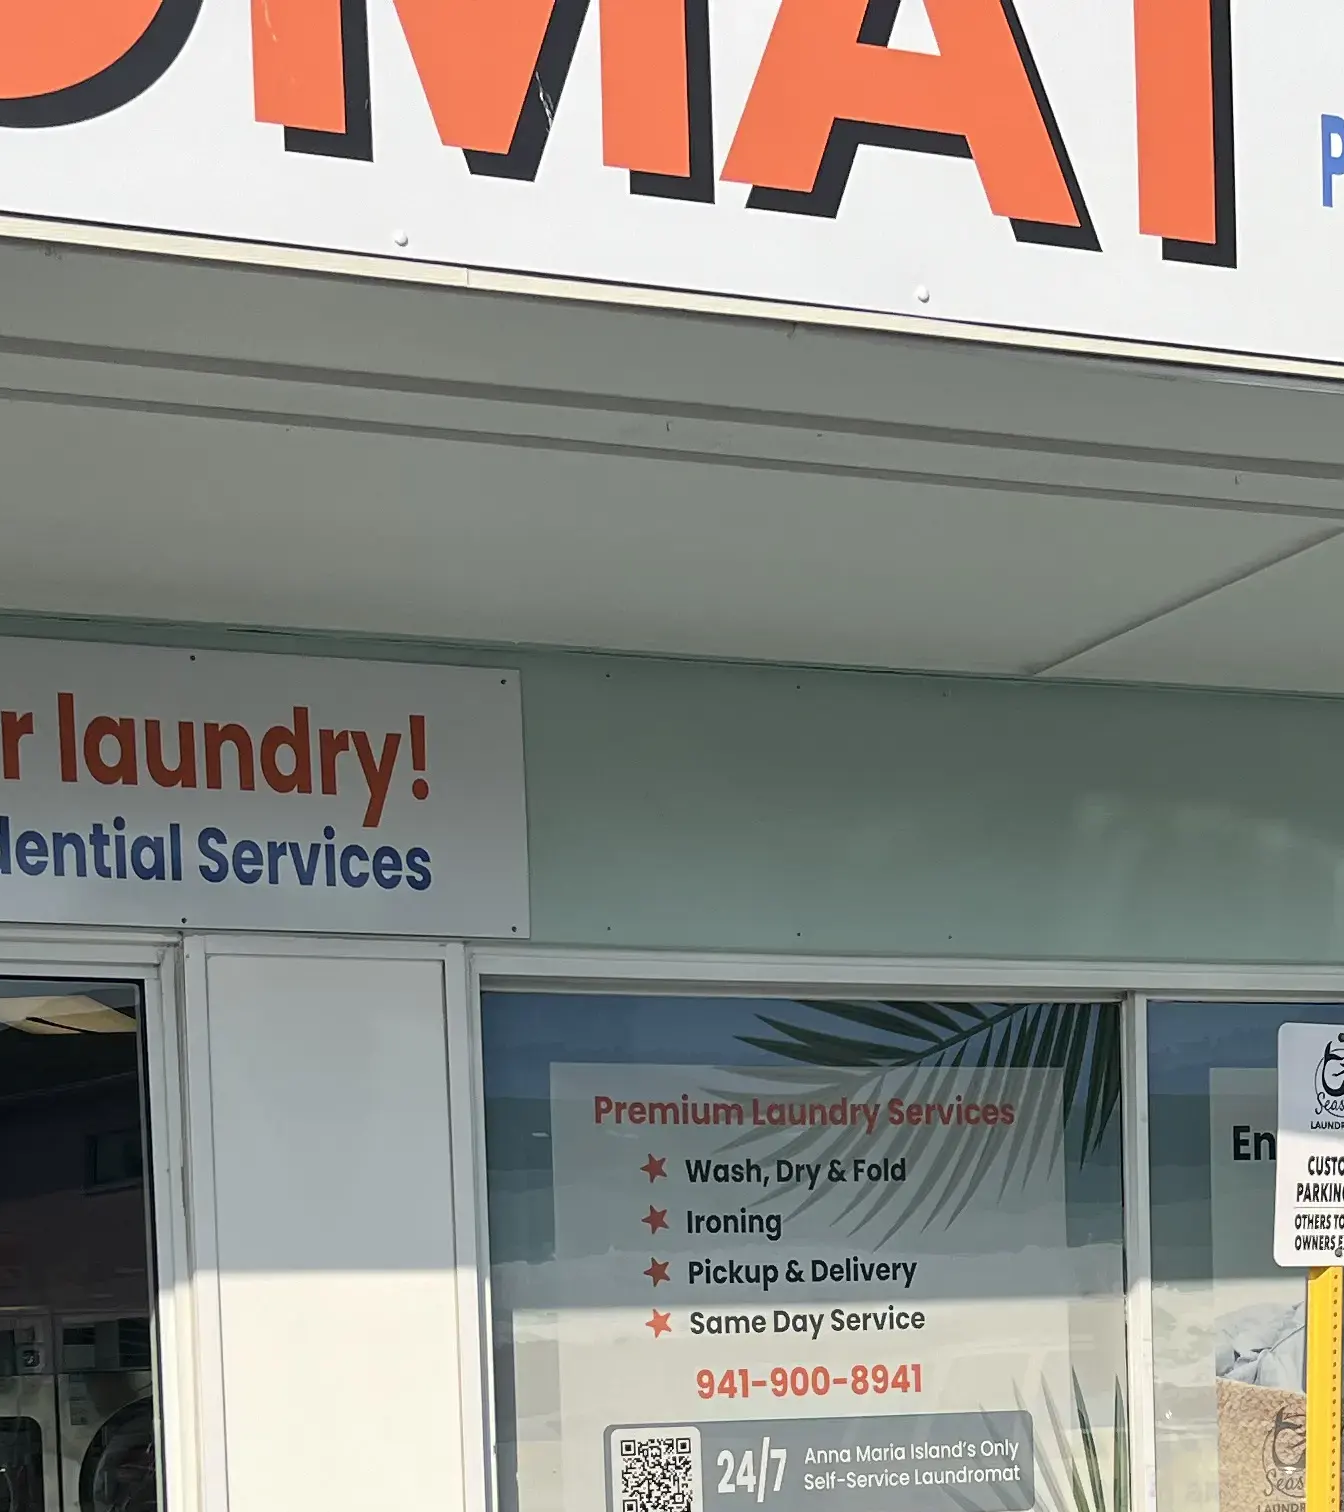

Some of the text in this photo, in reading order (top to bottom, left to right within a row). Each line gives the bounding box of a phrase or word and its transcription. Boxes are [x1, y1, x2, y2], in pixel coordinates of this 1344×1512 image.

[58, 692, 429, 828] laundry!
[197, 826, 432, 891] Services
[593, 1094, 1015, 1134] Premium Laundry Services
[685, 1157, 906, 1190] Wash, Dry & Fold
[686, 1207, 782, 1241] Ironing
[1294, 1214, 1331, 1230] OTHERS
[1294, 1235, 1336, 1251] OWNERS
[688, 1256, 918, 1291] Pickup & Delivery
[689, 1304, 926, 1340] Same Day Service
[696, 1364, 922, 1399] 941-900-8941
[804, 1438, 1020, 1465] Anna Maria Island’s Only
[716, 1436, 787, 1503] 24/7
[804, 1464, 1021, 1491] Self-Service Laundromat
[1263, 1468, 1305, 1496] Seas
